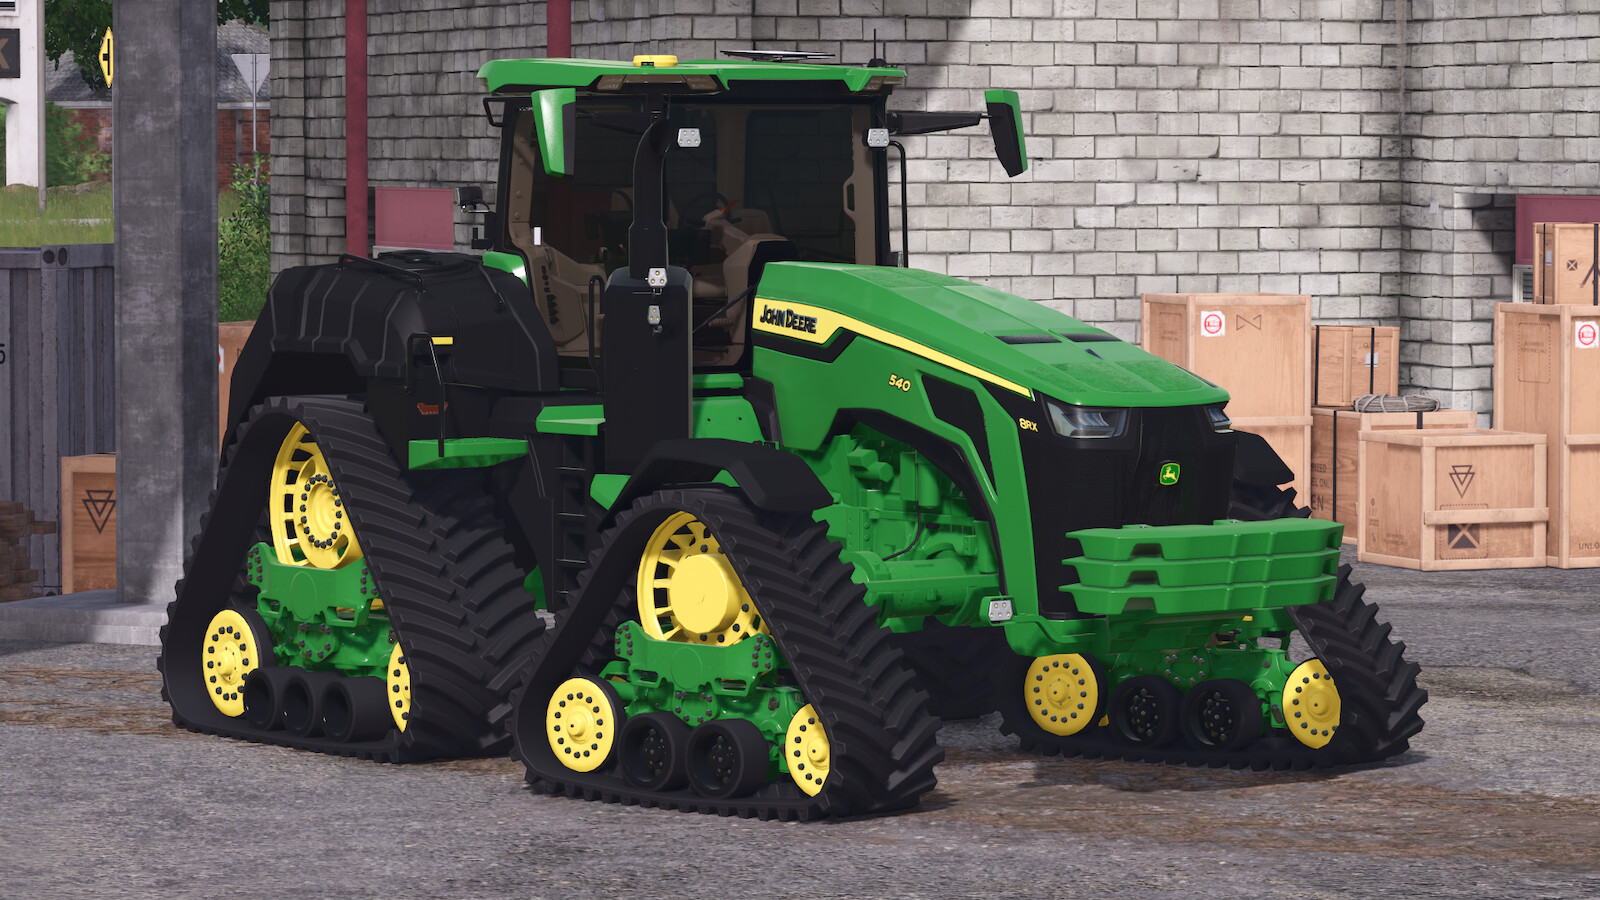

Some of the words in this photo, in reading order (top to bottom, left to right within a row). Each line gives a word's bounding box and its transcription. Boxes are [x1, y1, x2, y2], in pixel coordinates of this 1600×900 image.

[760, 304, 786, 328] JOHN
[786, 308, 817, 334] DEERE
[888, 373, 911, 392] 540
[1019, 417, 1039, 432] 8RX
